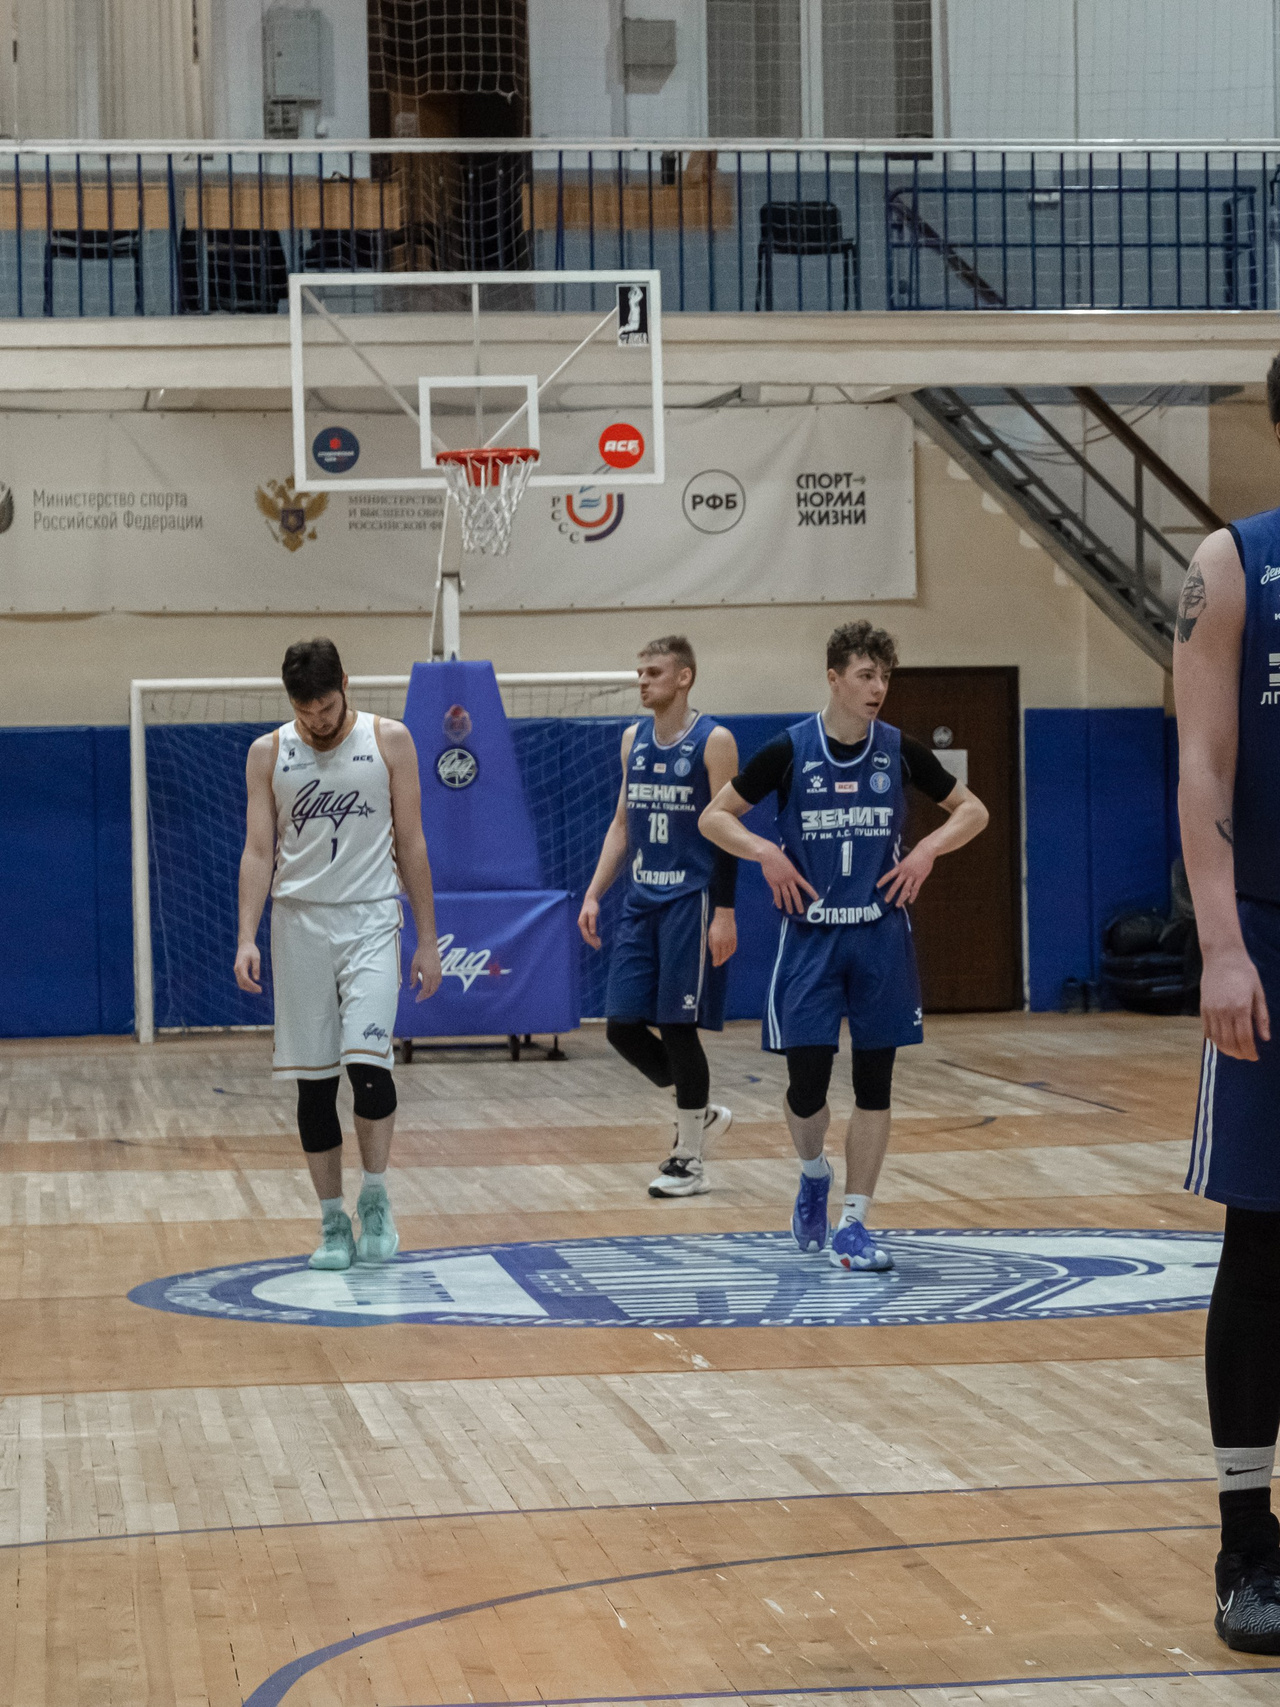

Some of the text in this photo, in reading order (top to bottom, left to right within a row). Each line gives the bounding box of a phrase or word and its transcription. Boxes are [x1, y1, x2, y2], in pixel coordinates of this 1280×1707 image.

[796, 472, 853, 490] СПОРТ
[33, 488, 188, 511] Министерство спорта
[692, 493, 737, 511] РФБ
[797, 491, 866, 509] НОРМА
[33, 508, 203, 533] Российской Федерации
[797, 508, 866, 527] ЖИЗНИ
[627, 783, 694, 803] ЗЕНИТ
[648, 812, 669, 844] 18
[801, 806, 893, 831] ЗЕНИТ
[331, 837, 338, 863] 1
[841, 840, 853, 876] 1
